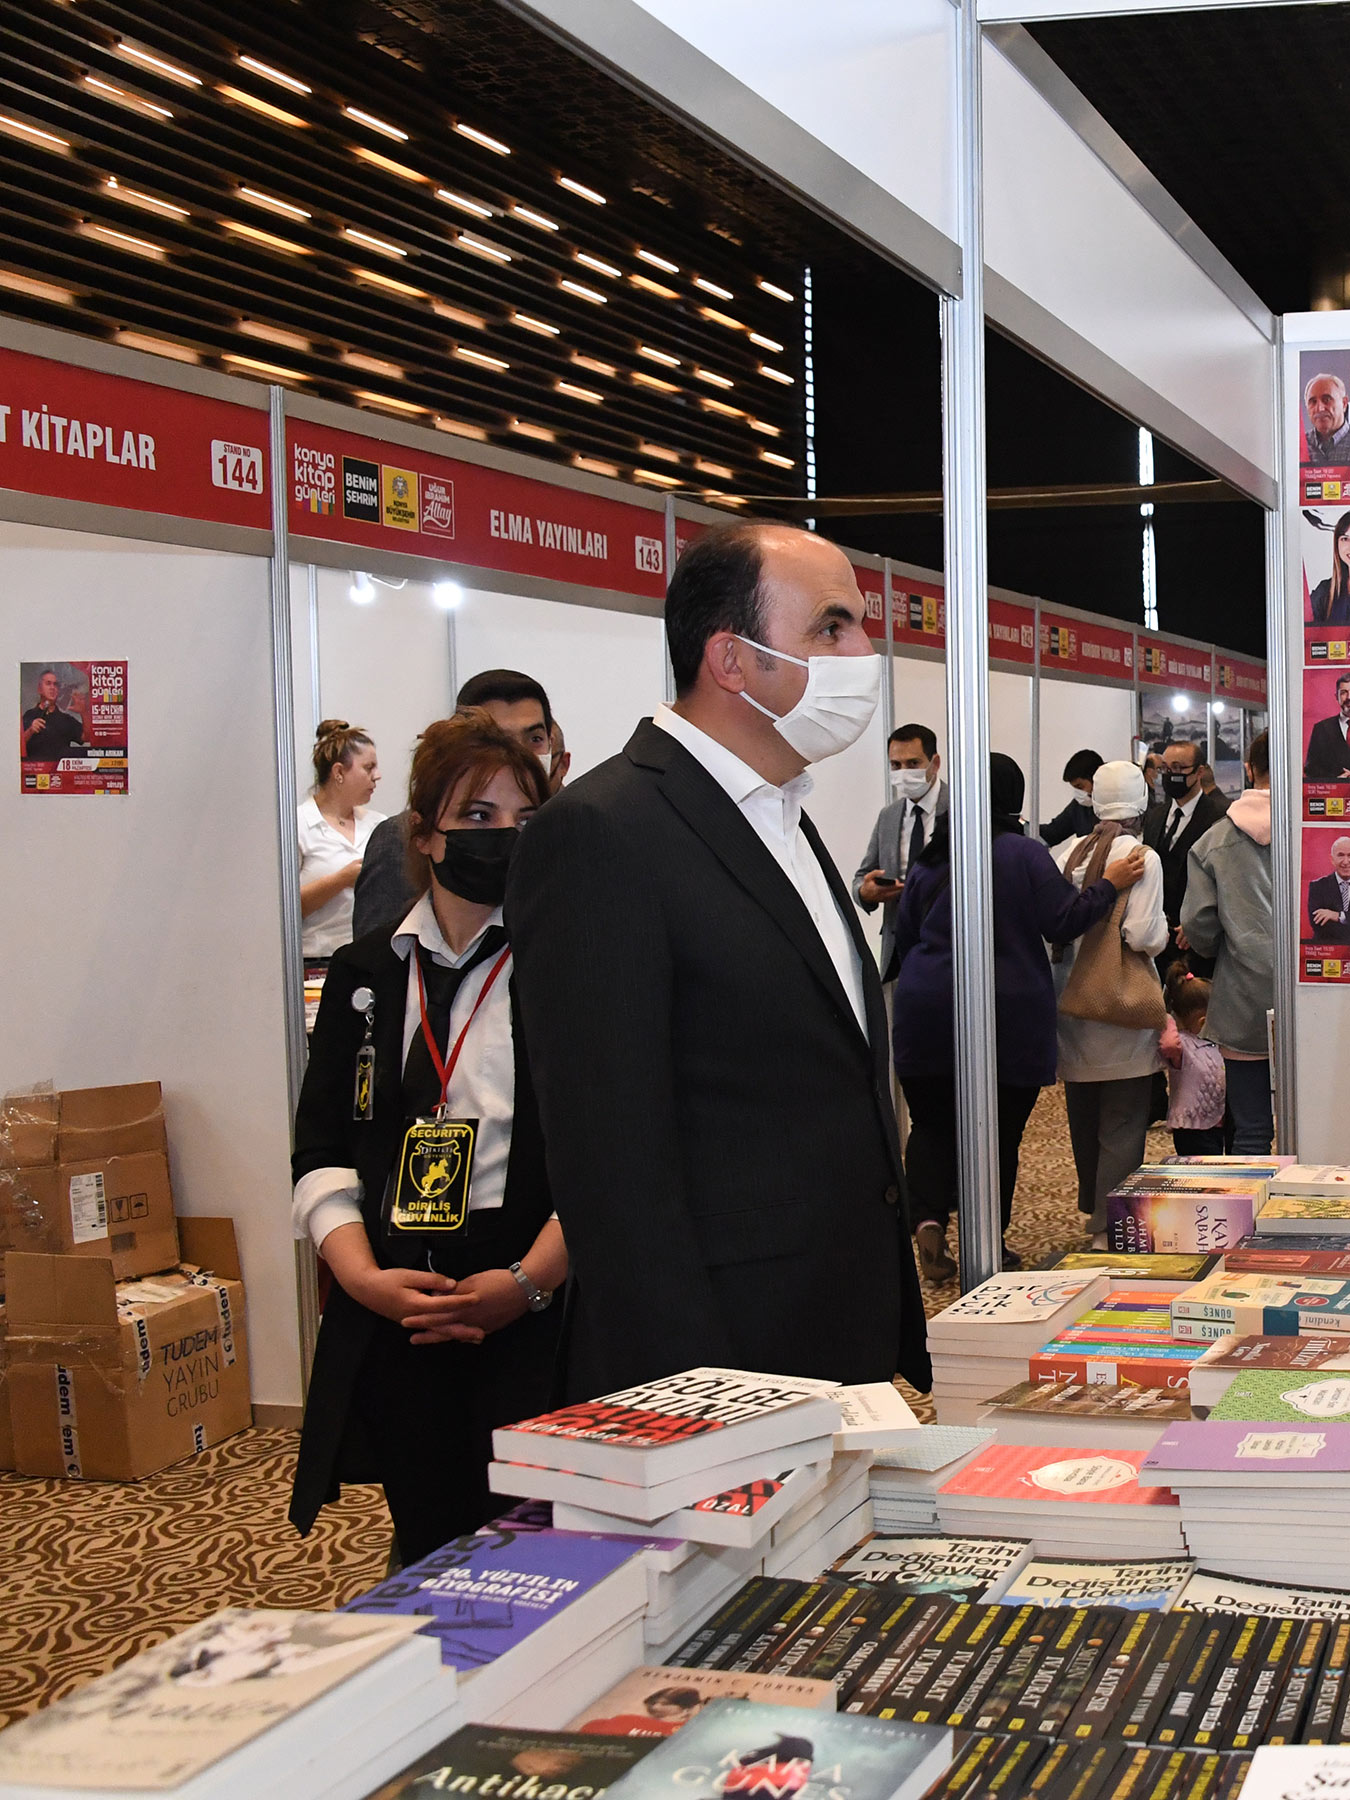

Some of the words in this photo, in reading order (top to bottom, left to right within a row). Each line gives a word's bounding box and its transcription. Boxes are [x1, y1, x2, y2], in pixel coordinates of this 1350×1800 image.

[22, 404, 156, 471] KİTAPLAR
[223, 444, 242, 457] STAND
[243, 447, 251, 457] NO
[294, 443, 334, 470] konya
[219, 455, 257, 490] 144
[295, 461, 335, 491] kitap
[295, 486, 335, 504] günleri
[490, 509, 533, 544] ELMA
[537, 520, 608, 560] YAYINLARI
[639, 546, 660, 571] 143
[868, 599, 881, 619] 143
[92, 665, 123, 677] konya
[92, 676, 123, 686] kitap
[92, 688, 123, 698] günleri
[62, 760, 70, 770] 18
[410, 1129, 468, 1138] SECURITY
[399, 1212, 459, 1223] GÜVENLİK
[408, 1201, 451, 1213] DİRİLİŞ
[1203, 1306, 1232, 1318] GÜNEŞ
[1305, 1316, 1340, 1327] kendini
[161, 1326, 218, 1365] TUDEM
[163, 1352, 219, 1392] YAYIN
[641, 1375, 813, 1408] GÖLGE
[702, 1498, 753, 1515] ÖZAL
[860, 1550, 1014, 1569] Değiştiren
[947, 1541, 1025, 1559] Tarihi
[442, 1567, 475, 1583] 20.
[482, 1569, 580, 1593] YÜZYILIN
[847, 1570, 889, 1583] Ali
[894, 1570, 995, 1589] Çimen
[898, 1560, 1003, 1580] Olaylar
[1112, 1565, 1191, 1580] Tarihi
[418, 1578, 566, 1604] BİYOGRAFİSİ
[1024, 1574, 1185, 1591] Değiştiren
[1058, 1587, 1176, 1600] Liderler
[641, 1669, 724, 1692] BENJAMIN
[752, 1680, 816, 1695] FORTNA
[891, 1659, 935, 1699] MURAT
[923, 1662, 967, 1703] MURAT
[1017, 1668, 1058, 1709] MURAT
[1213, 1666, 1239, 1690] HALİD
[1252, 1670, 1276, 1693] HALİD
[1275, 1676, 1306, 1723] MEVLANA
[1310, 1678, 1340, 1725] MEVLANA
[1197, 1706, 1225, 1732] VELİD
[1235, 1710, 1261, 1735] VELİD
[717, 1748, 844, 1786] KARA
